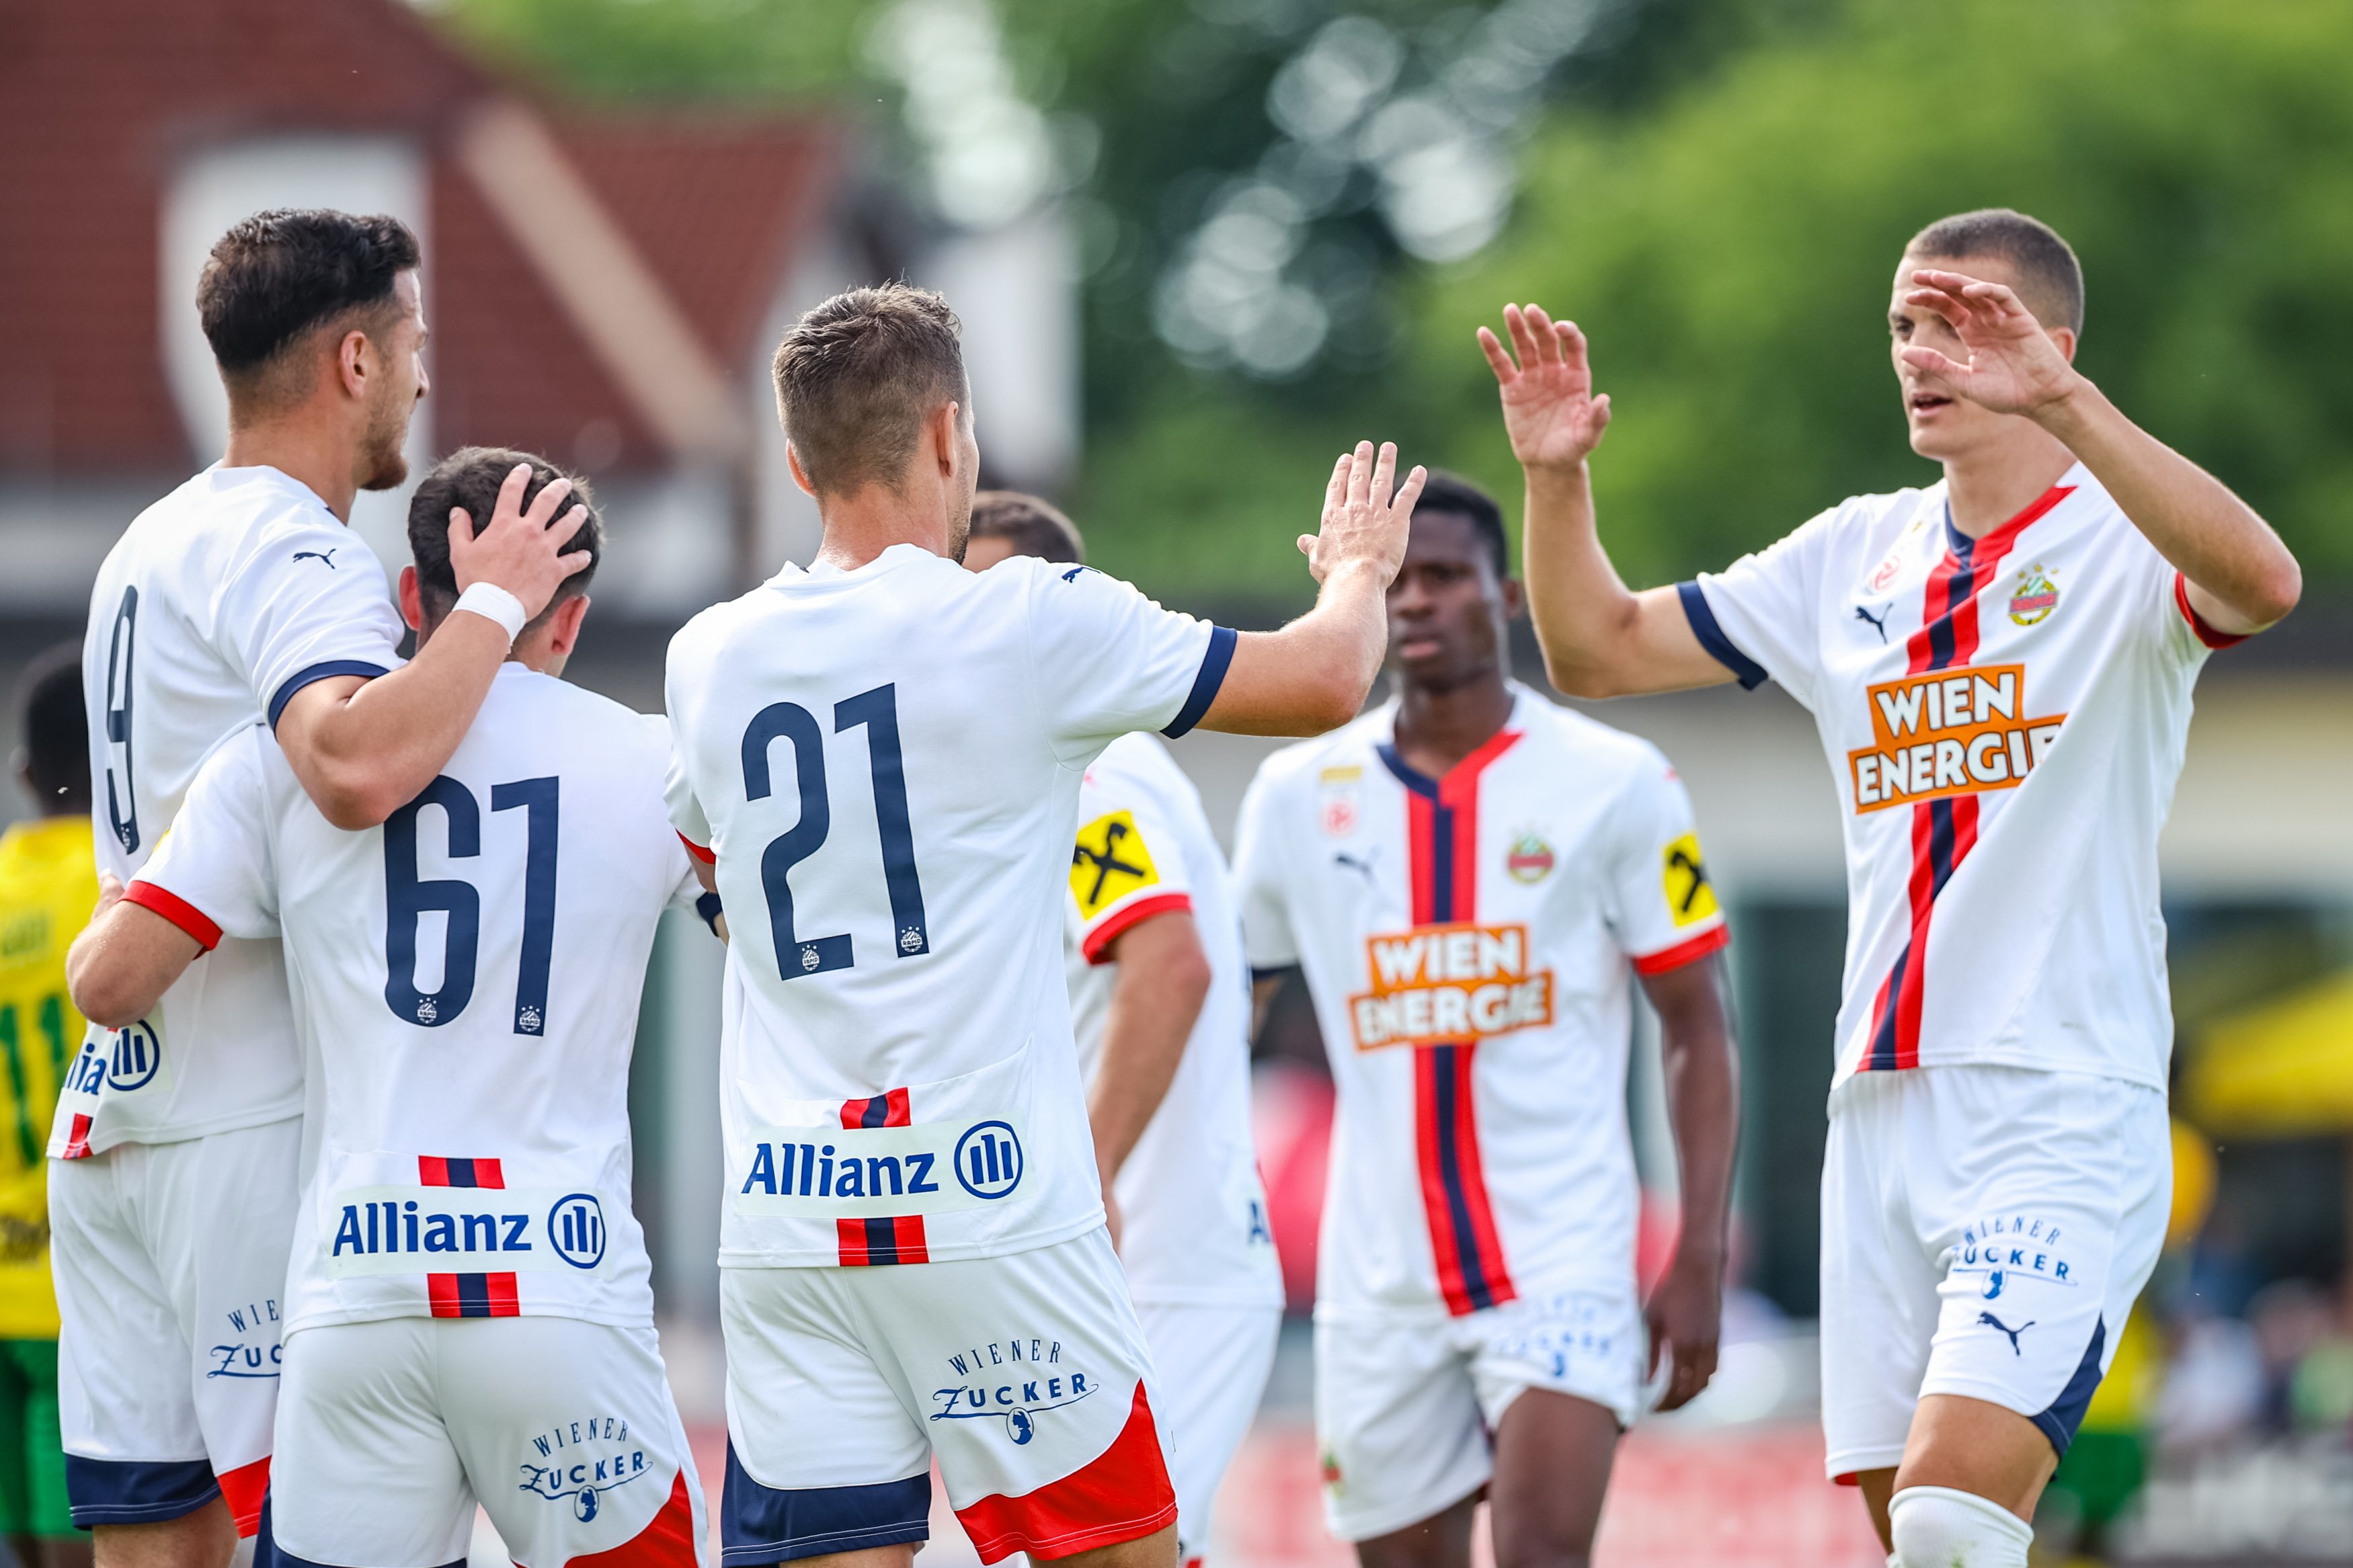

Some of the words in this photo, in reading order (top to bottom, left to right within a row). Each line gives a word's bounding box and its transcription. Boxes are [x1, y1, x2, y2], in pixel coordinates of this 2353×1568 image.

[107, 585, 139, 855] 9
[1876, 673, 2016, 738] WIEN
[742, 682, 929, 981] 21
[384, 774, 559, 1036] 61
[1373, 930, 1521, 986] WIEN
[1358, 979, 1546, 1044] ENERGIE
[741, 1143, 939, 1197] Allianz
[333, 1201, 532, 1256] Allianz
[1964, 1216, 2061, 1245] WIENER
[948, 1339, 1060, 1376] WIENER
[930, 1373, 1090, 1421] ZUCKER
[532, 1418, 628, 1457] WIENER
[519, 1451, 648, 1492] ZUCKER
